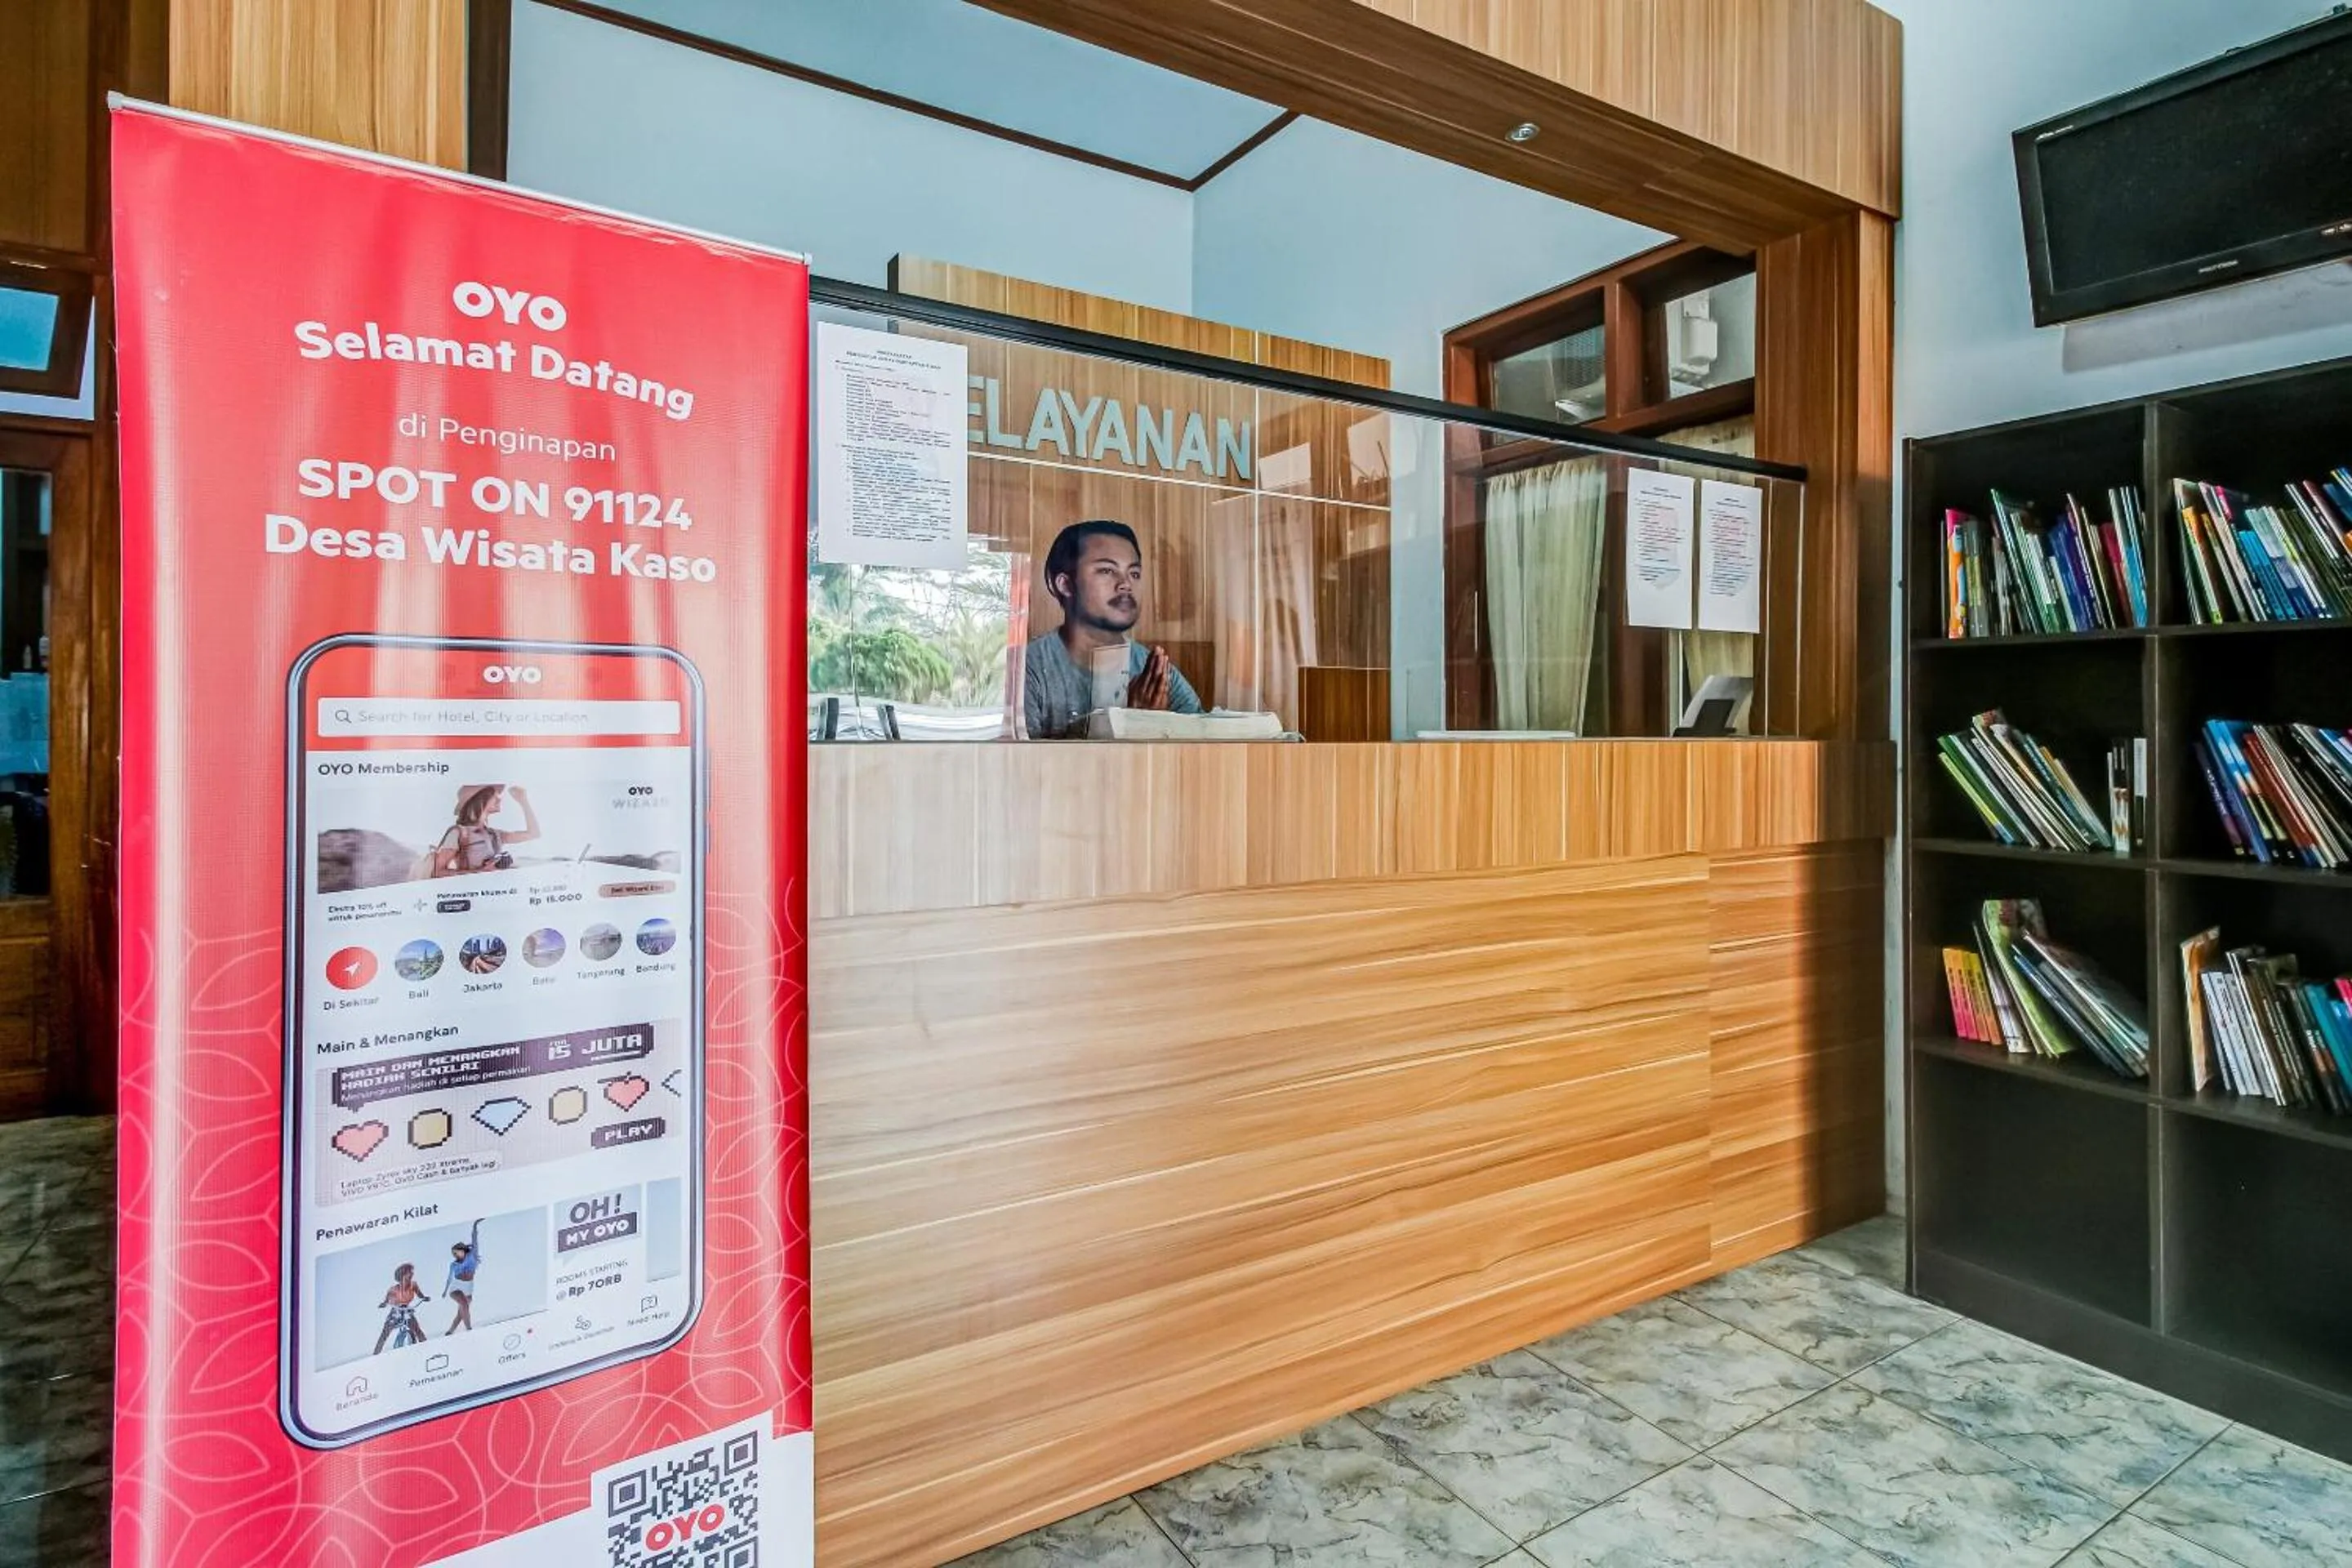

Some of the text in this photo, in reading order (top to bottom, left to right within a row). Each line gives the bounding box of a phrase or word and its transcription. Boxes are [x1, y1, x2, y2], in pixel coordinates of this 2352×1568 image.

[452, 281, 567, 332] OYO
[294, 321, 694, 420] Selamat Datang
[399, 412, 616, 463] di Penginapan
[298, 459, 693, 532] SPOT ON 91124
[265, 514, 716, 583] Desa Wisata Kaso
[483, 666, 542, 684] OYO
[358, 710, 408, 724] Search
[484, 710, 513, 725] City
[515, 713, 530, 724] or
[318, 761, 450, 776] OYO Membership
[628, 786, 654, 796] OYO
[408, 989, 430, 1000] Bali
[462, 982, 503, 994] Jakarta
[323, 1000, 336, 1011] Di
[316, 1025, 460, 1054] Main & Menangkan
[581, 1033, 643, 1055] JUTA
[341, 1065, 386, 1080] MAIN
[390, 1058, 424, 1073] DAN
[604, 1123, 653, 1141] PLAY
[316, 1203, 439, 1241] Penawaran Kilat
[566, 1219, 630, 1245] MY OYO
[568, 1285, 586, 1298] Rp
[497, 1352, 527, 1365] Offers
[644, 1503, 725, 1552] OYO
